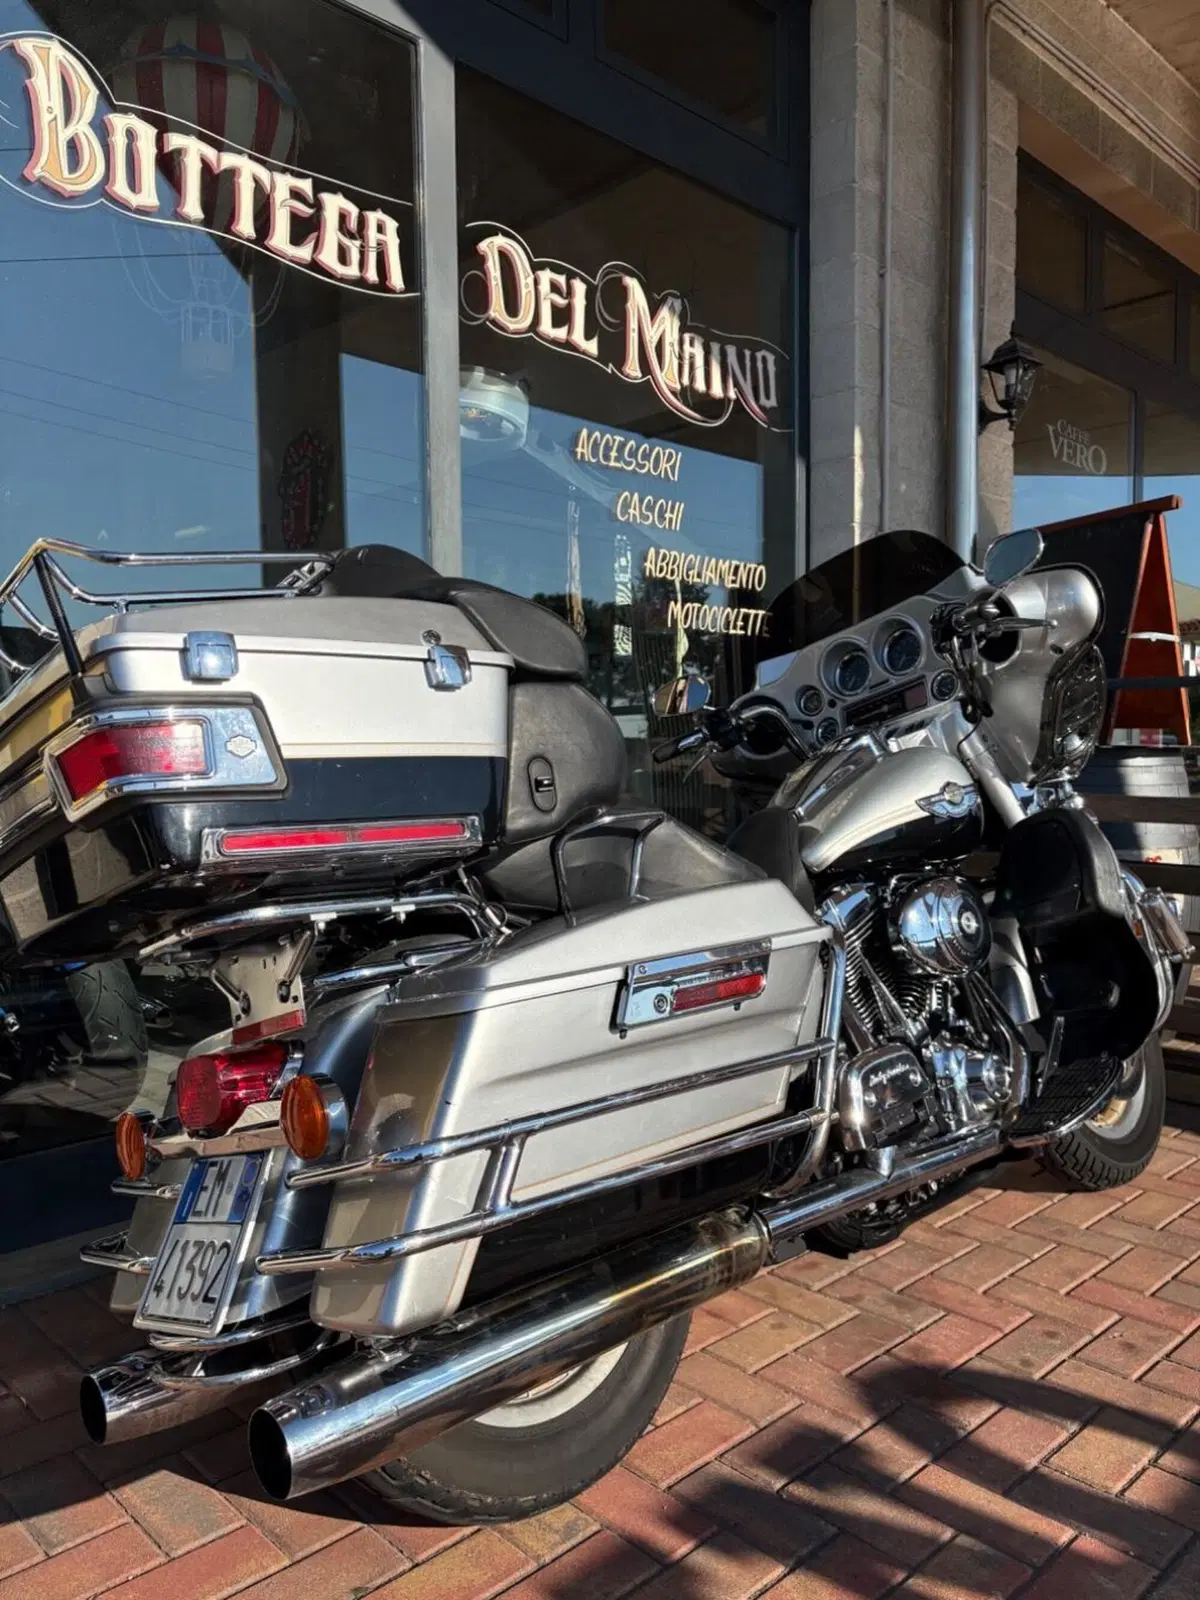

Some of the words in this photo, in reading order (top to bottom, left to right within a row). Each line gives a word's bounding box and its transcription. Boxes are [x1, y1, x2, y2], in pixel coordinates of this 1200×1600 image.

[13, 37, 406, 293] BOTTEGA
[476, 232, 599, 358] DEL
[575, 427, 682, 482] ACCESSORI
[1045, 423, 1107, 475] VERO
[616, 491, 685, 531] CASCHI
[644, 547, 767, 592] ABBIGLIAMENTO
[667, 600, 773, 638] MOTOCICLETTE
[153, 1238, 232, 1304] 41392
